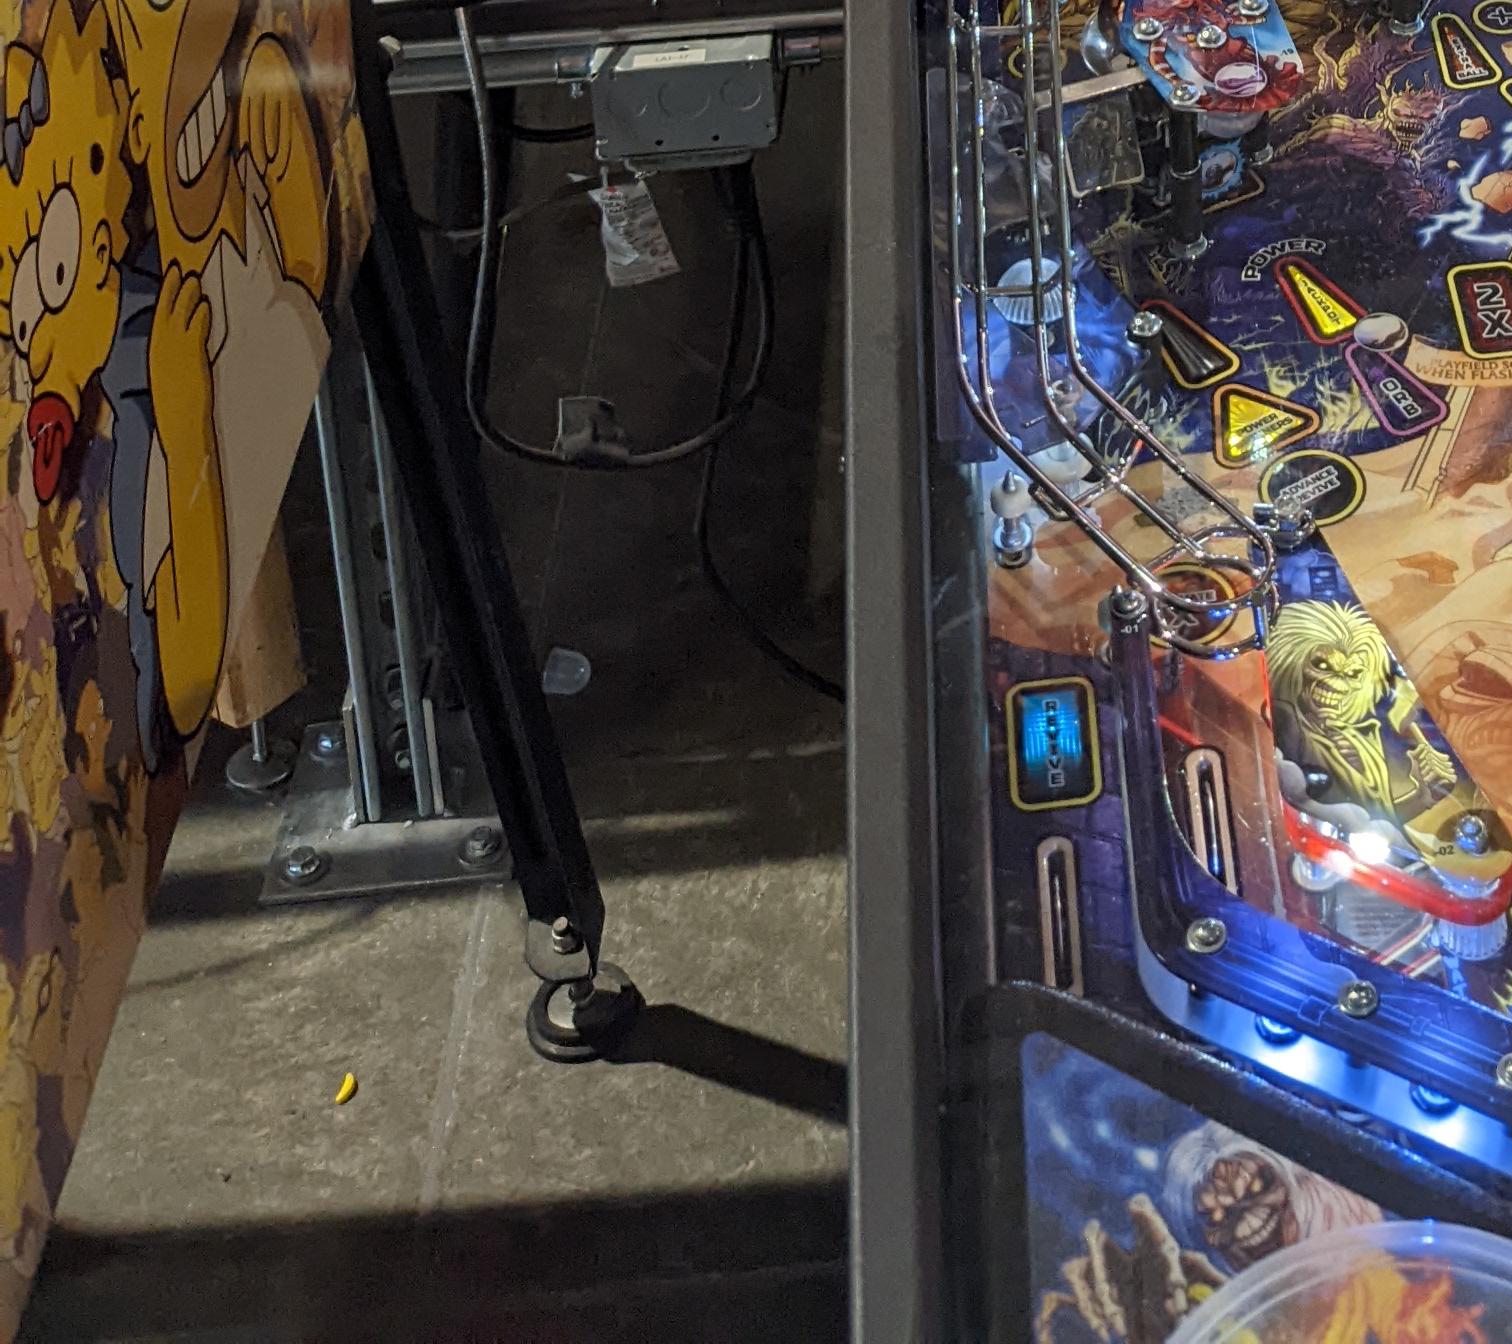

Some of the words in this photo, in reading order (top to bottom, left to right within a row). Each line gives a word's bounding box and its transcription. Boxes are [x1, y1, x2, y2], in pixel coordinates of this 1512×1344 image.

[1241, 238, 1327, 281] POWER
[1415, 364, 1469, 380] WHEN
[1432, 359, 1500, 372] PLAYFIELD
[1379, 376, 1423, 420] ORB
[1279, 465, 1339, 498] ADVANCE
